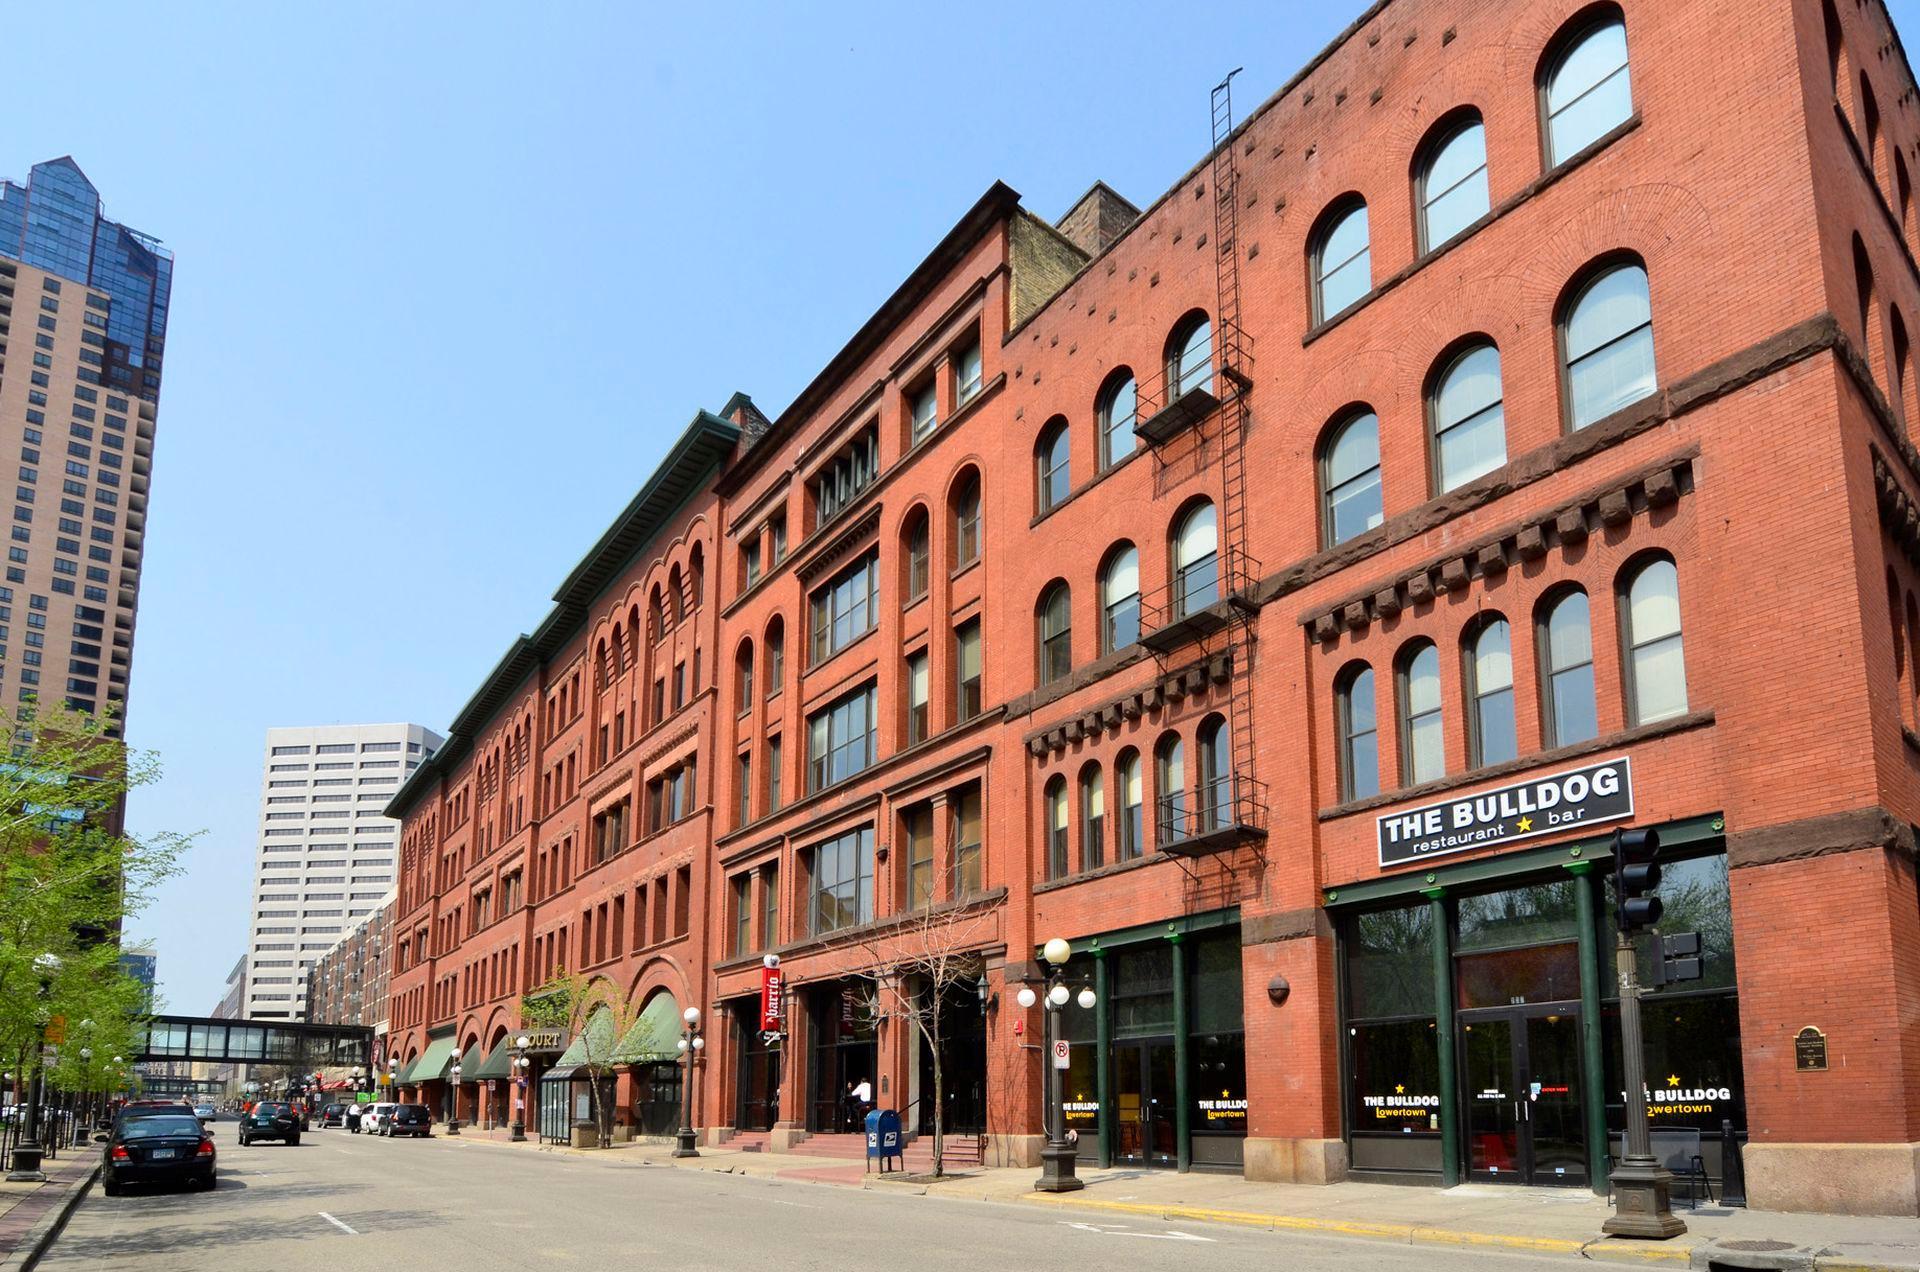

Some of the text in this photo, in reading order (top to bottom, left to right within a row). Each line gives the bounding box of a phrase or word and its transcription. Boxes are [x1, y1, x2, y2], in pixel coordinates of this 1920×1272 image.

[1385, 767, 1620, 843] THE BULLDOG
[1413, 808, 1586, 853] restaurant bar
[765, 977, 779, 1016] barrio
[526, 1033, 560, 1047] OURT
[1363, 1095, 1440, 1107] THE BULLDOG
[1621, 1088, 1731, 1103] TE BULLDOG
[1062, 1102, 1072, 1110] HE
[1198, 1100, 1248, 1110] THE BULLDO
[1647, 1104, 1712, 1117] owertown
[1207, 1110, 1245, 1120] Lowertown
[1376, 1107, 1427, 1119] Lowertown
